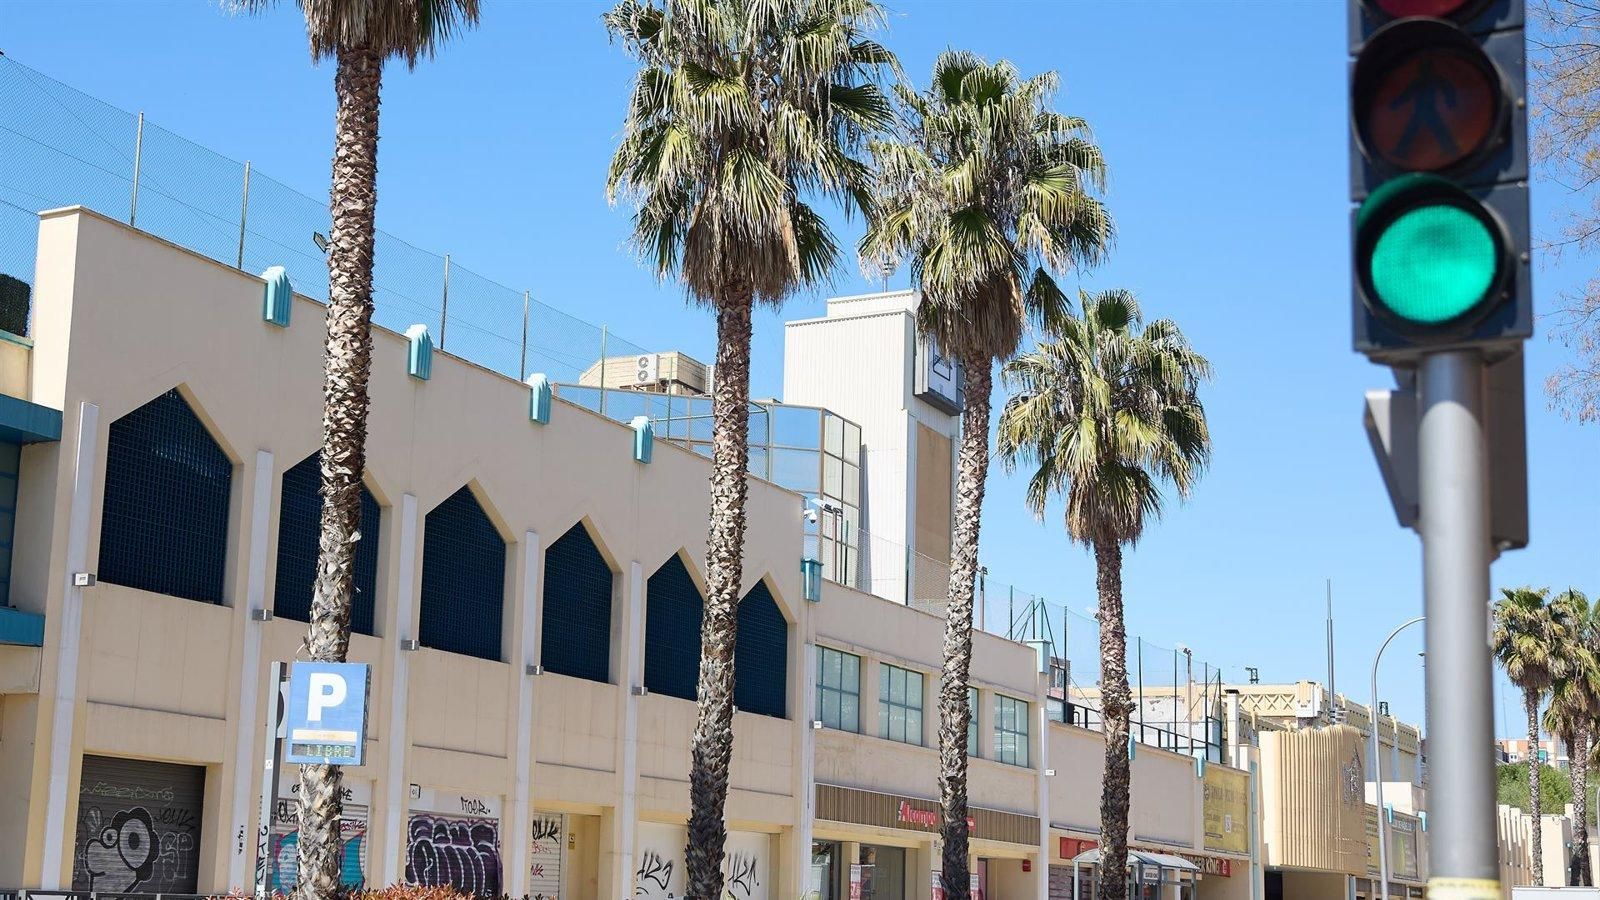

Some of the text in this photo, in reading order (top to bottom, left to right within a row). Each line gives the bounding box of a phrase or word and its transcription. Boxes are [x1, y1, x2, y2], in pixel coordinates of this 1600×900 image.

[307, 673, 347, 721] P
[306, 744, 351, 757] LIBRE
[1206, 856, 1220, 875] KING
